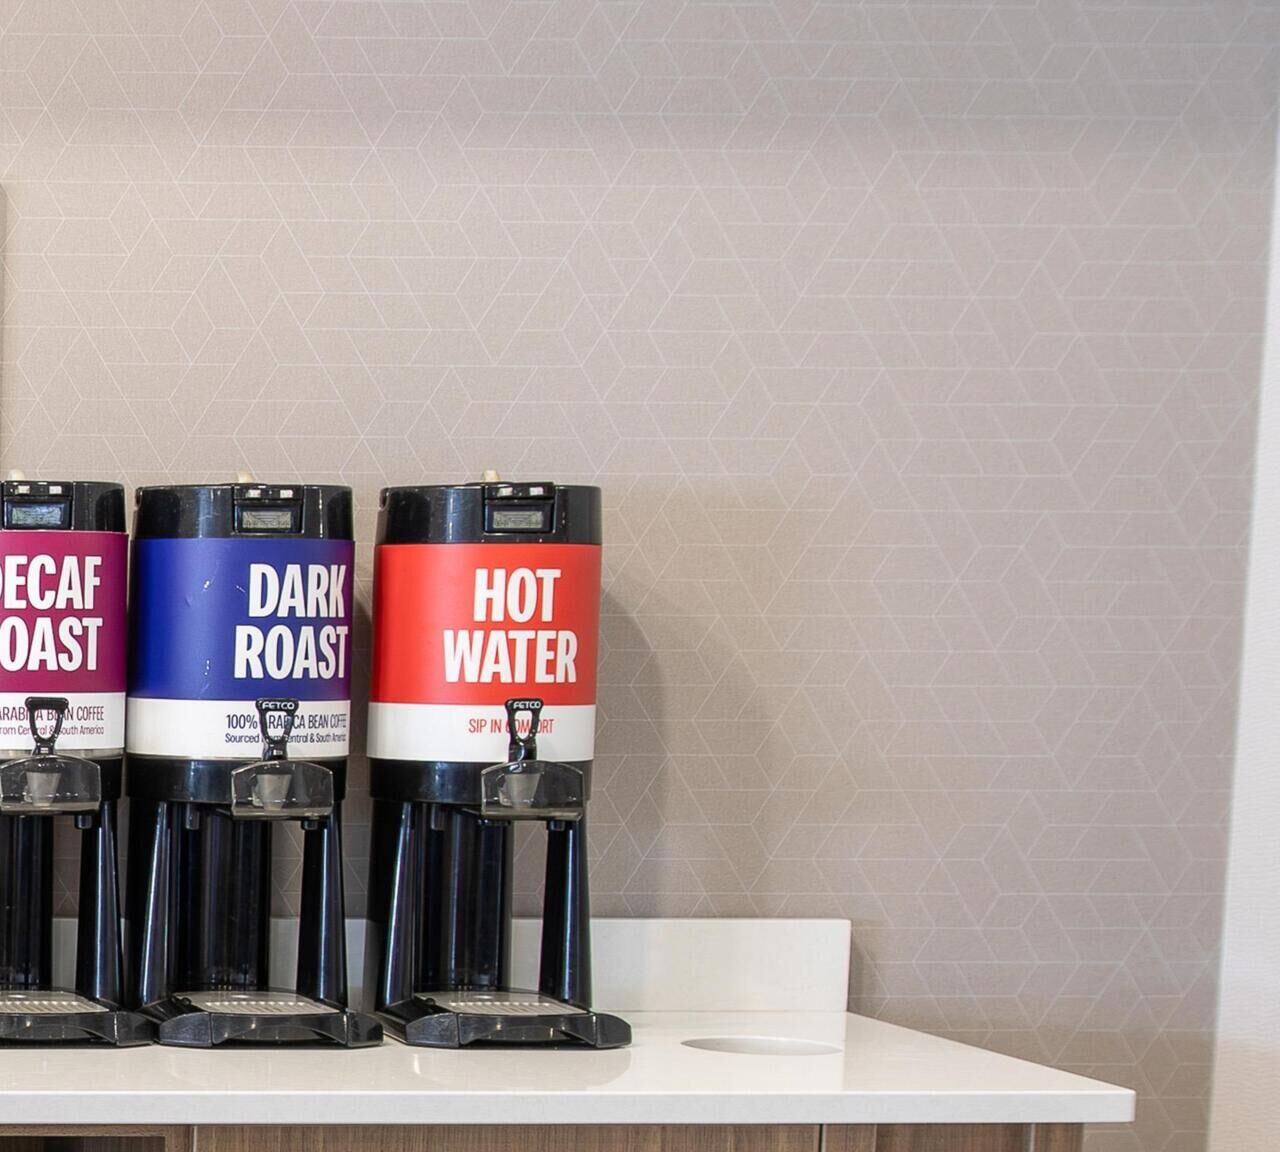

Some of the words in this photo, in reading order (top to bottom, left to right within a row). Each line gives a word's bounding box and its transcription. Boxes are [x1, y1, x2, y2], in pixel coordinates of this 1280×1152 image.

[248, 563, 347, 618] DARK
[473, 567, 562, 623] HOT
[234, 624, 349, 680] ROAST
[443, 629, 578, 684] WATER
[262, 701, 295, 710] FETCO
[513, 700, 541, 709] FETCO
[76, 706, 105, 721] COFFEE
[225, 714, 258, 729] 100%
[265, 714, 306, 729] RABCA
[308, 714, 328, 729] BEAN
[468, 719, 487, 734] SIP
[490, 719, 502, 734] IN
[505, 718, 554, 734] COMORT
[17, 725, 48, 736] Cenal
[58, 725, 79, 735] outh
[79, 725, 105, 735] America
[225, 733, 260, 743] Sourced
[285, 732, 308, 743] entral
